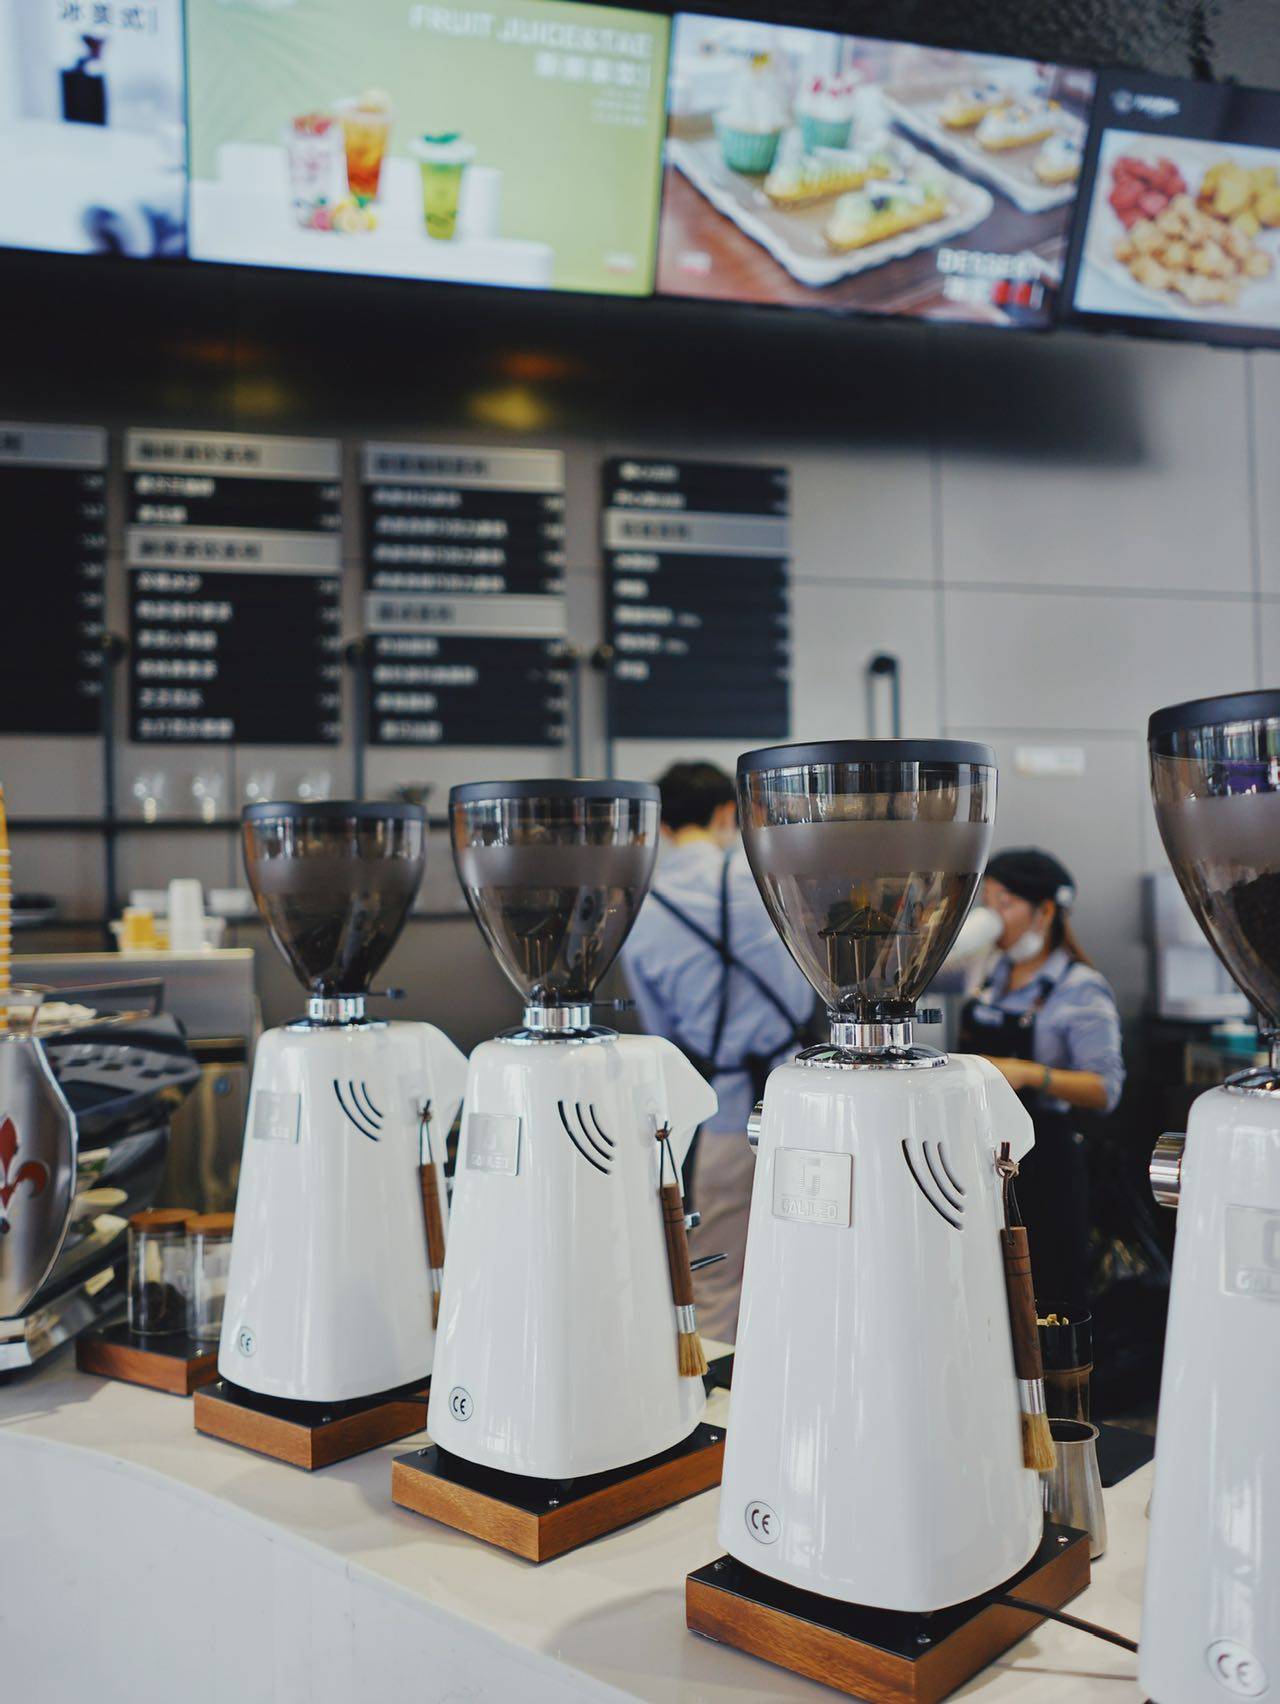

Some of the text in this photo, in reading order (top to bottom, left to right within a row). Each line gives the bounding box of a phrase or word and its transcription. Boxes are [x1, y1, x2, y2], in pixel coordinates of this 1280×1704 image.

[452, 1395, 467, 1416] CE
[751, 1508, 771, 1535] CE
[1216, 1653, 1250, 1687] CE
